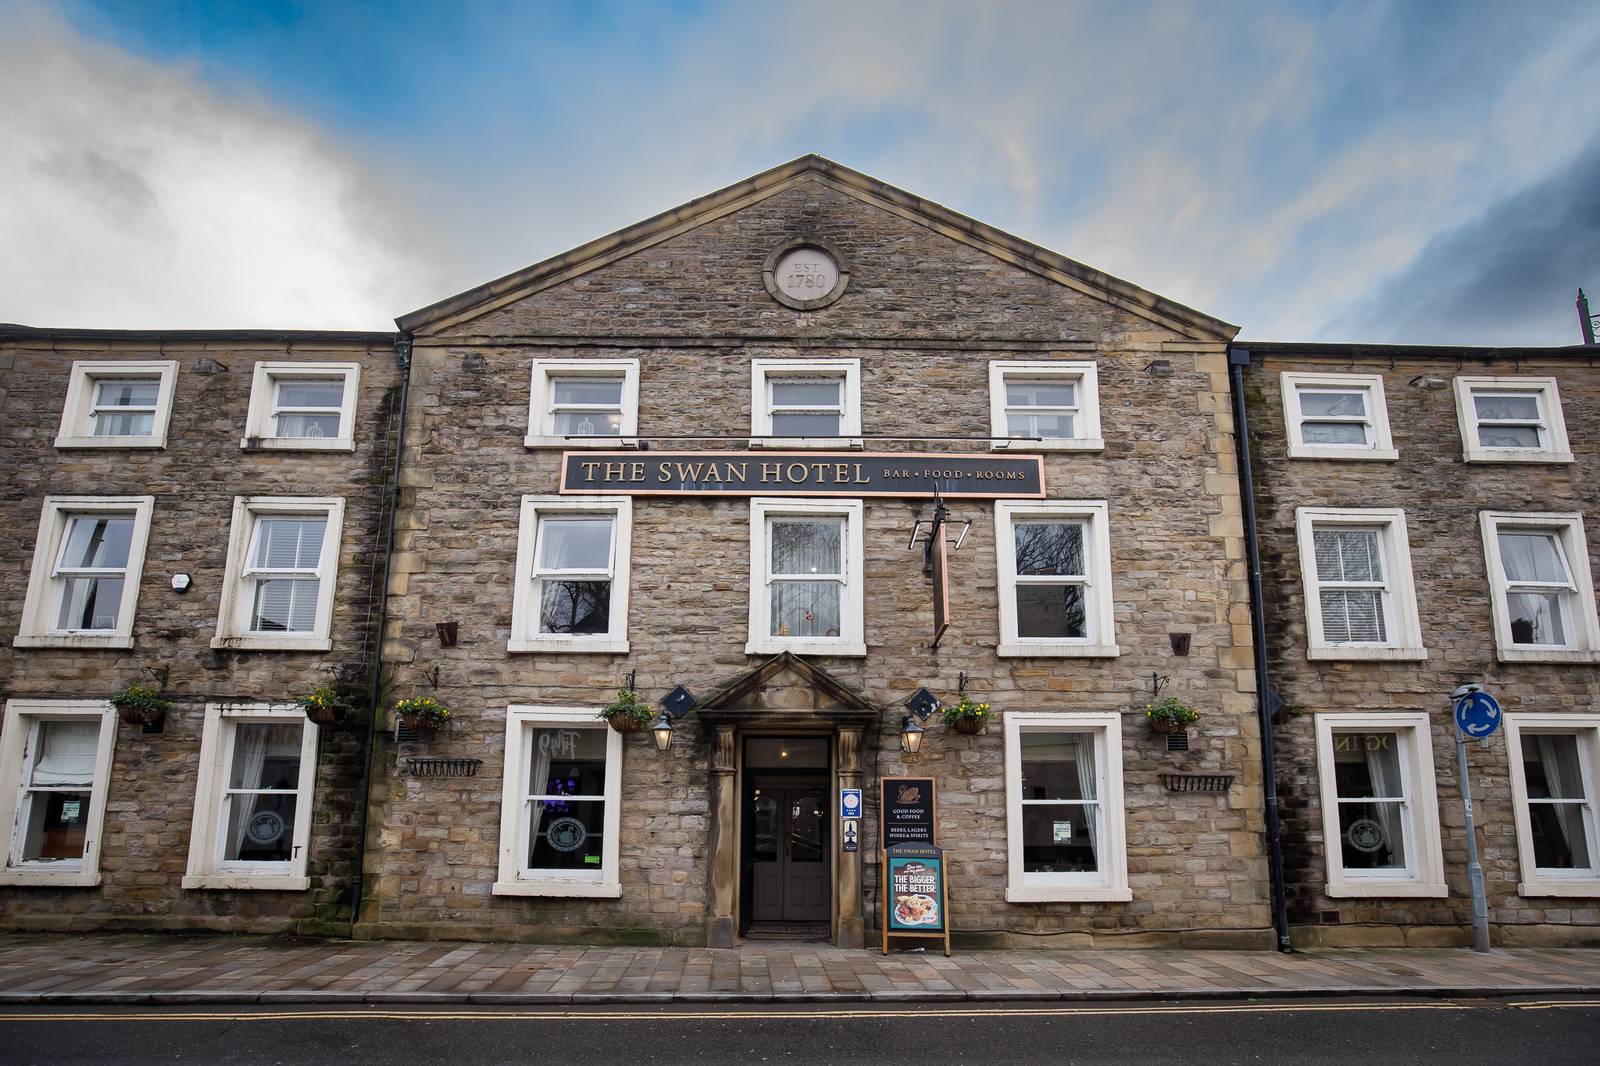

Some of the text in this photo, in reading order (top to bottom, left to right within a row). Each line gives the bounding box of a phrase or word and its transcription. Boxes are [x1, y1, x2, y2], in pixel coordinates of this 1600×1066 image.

[787, 274, 825, 288] 1780
[581, 462, 871, 483] THE SWAN HOTEL
[883, 469, 1025, 480] BAR FOOD ROOMS
[894, 875, 908, 884] THE
[894, 884, 908, 892] THE
